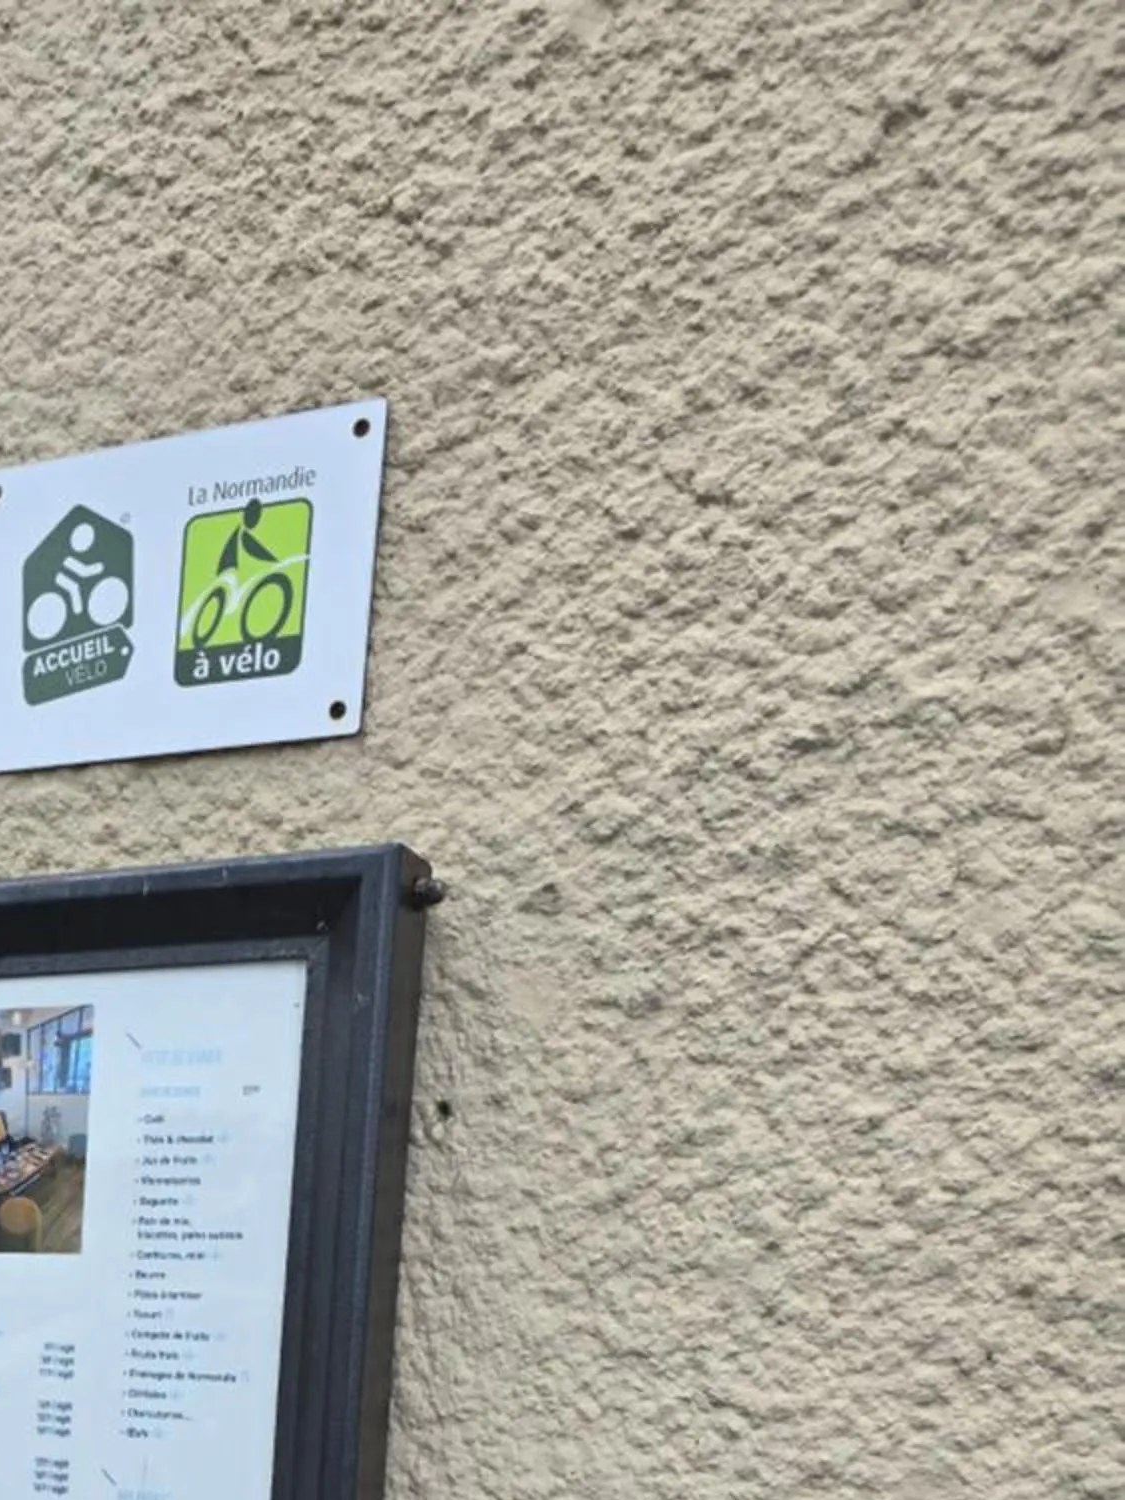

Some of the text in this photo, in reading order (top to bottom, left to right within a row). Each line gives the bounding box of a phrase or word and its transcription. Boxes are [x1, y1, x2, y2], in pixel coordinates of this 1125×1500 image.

[188, 467, 317, 506] La Normandie
[33, 635, 115, 677] ACCUEIL
[192, 641, 282, 680] à vélo
